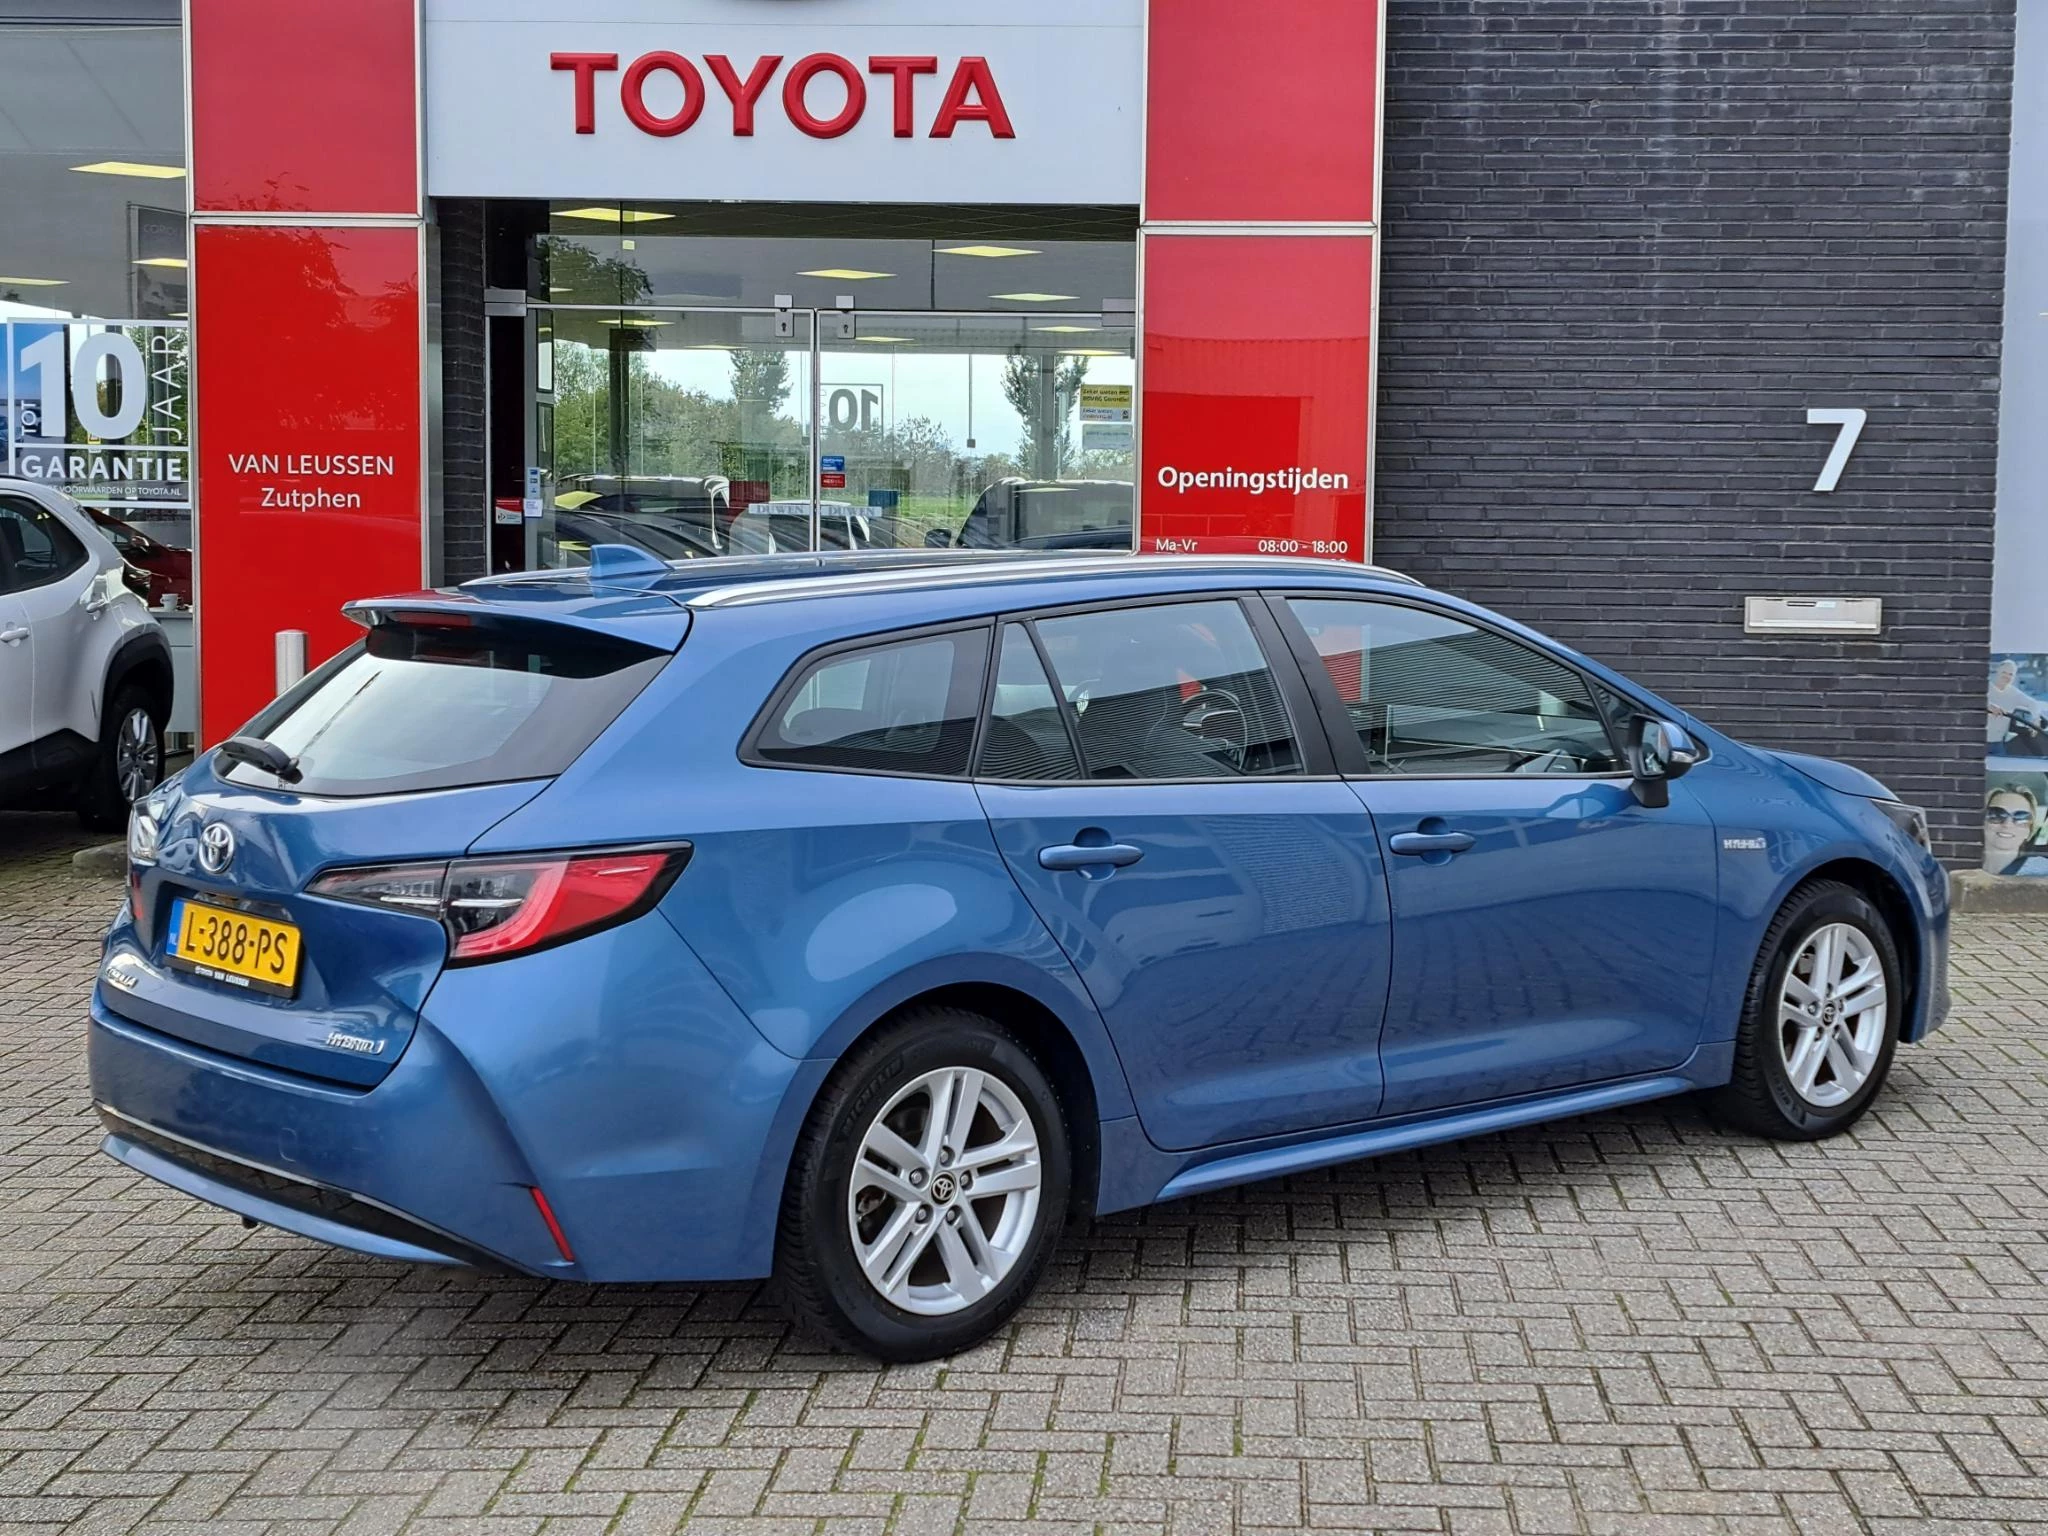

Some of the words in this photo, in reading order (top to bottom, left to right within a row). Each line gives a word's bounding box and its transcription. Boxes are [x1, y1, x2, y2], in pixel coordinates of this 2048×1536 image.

[550, 51, 1016, 139] TOYOTA
[20, 332, 147, 440] 10
[151, 329, 186, 441] JAAR
[20, 400, 37, 436] TOT
[20, 455, 183, 481] GARANTIE
[228, 454, 279, 474] VAN
[287, 455, 394, 476] LEUSSEN
[1807, 409, 1866, 492] 7
[1157, 466, 1349, 495] Openingstijden
[261, 487, 361, 513] Zutphen
[1155, 539, 1198, 552] Ma-Vr
[1258, 540, 1299, 553] 08:00
[1311, 540, 1348, 554] 18:00
[185, 911, 288, 974] L-388-PS
